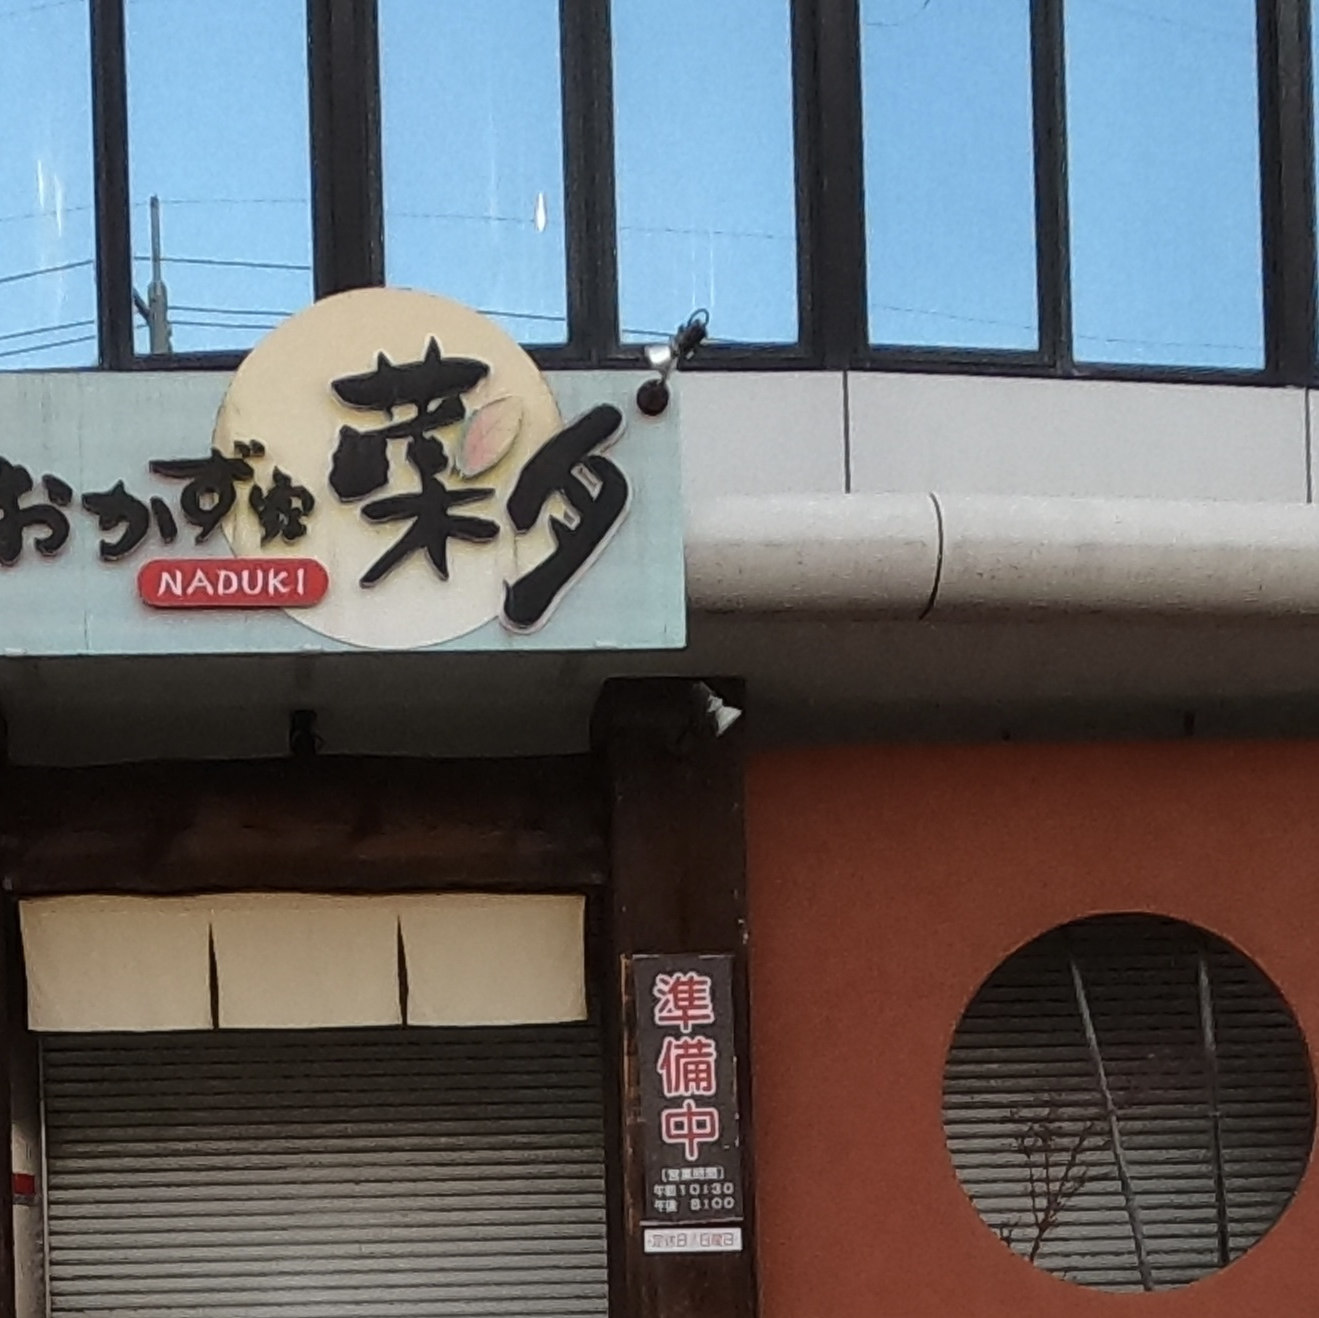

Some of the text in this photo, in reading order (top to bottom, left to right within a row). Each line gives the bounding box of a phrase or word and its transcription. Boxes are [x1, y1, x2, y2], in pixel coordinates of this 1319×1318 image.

[157, 567, 307, 598] NADUKI
[653, 971, 720, 1161] 準備中
